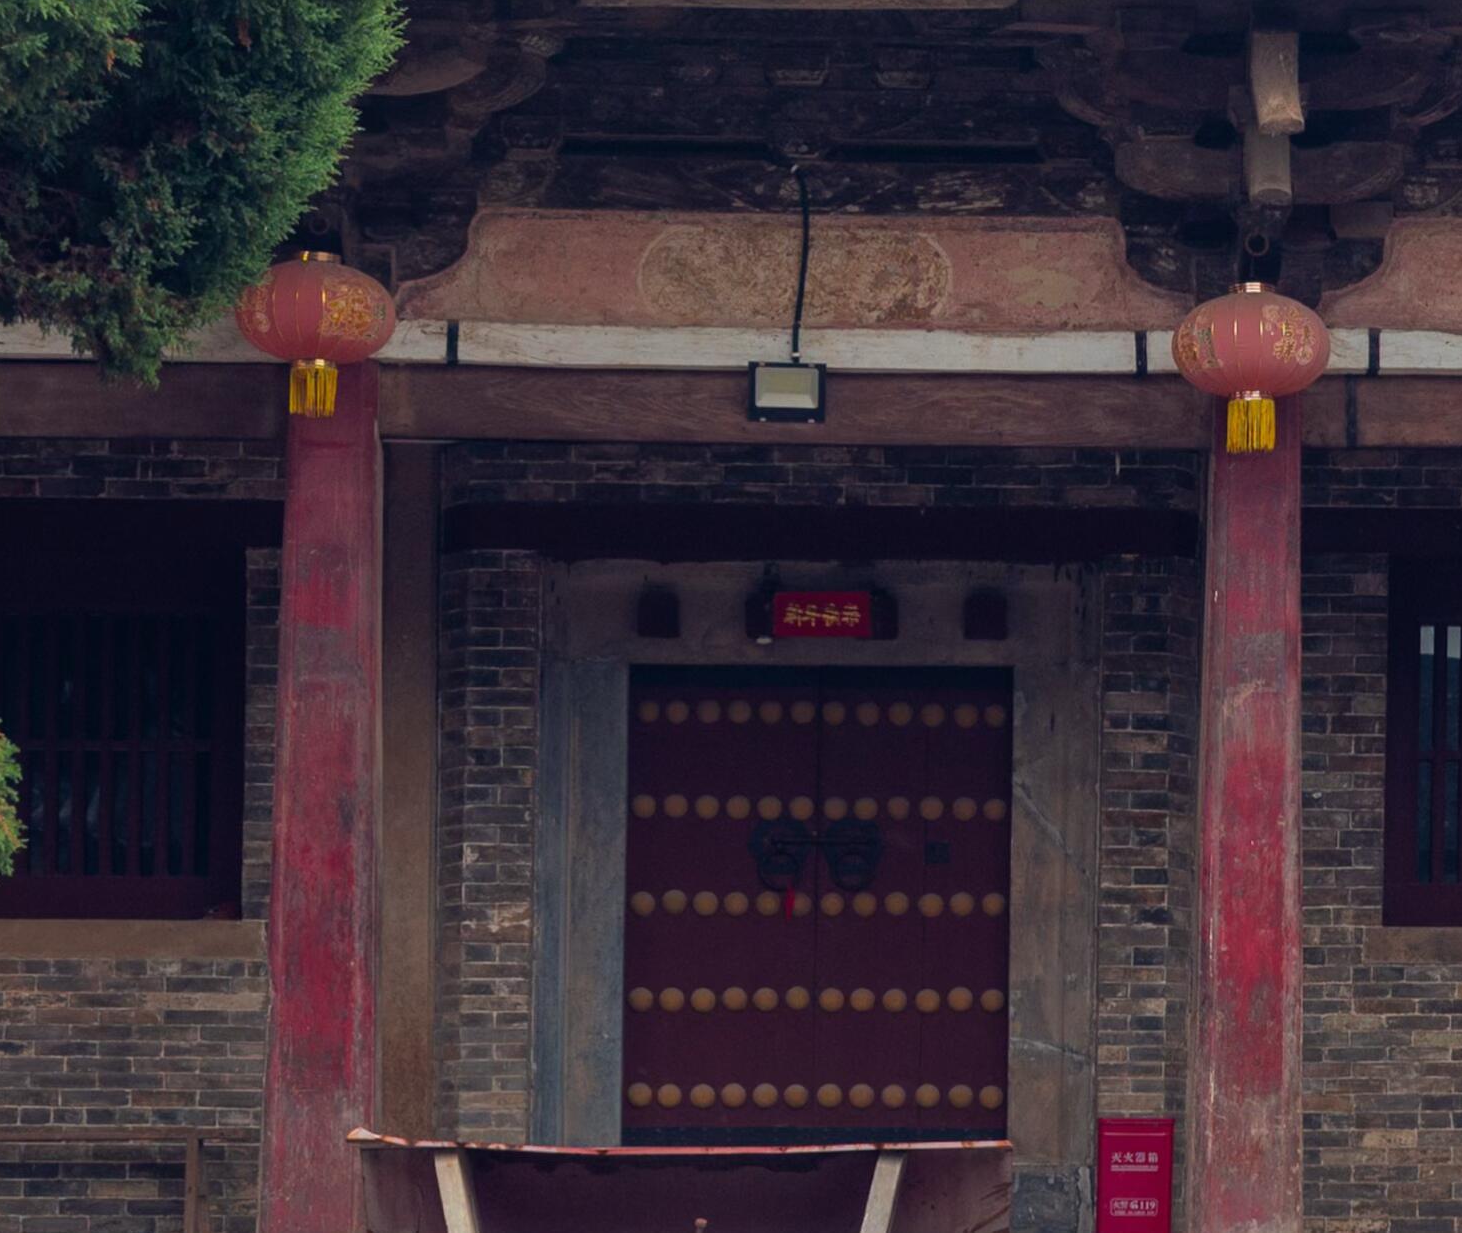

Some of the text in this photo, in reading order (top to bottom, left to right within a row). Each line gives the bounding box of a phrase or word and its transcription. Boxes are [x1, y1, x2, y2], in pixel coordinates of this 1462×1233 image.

[1112, 1152, 1158, 1163] 灭火器箱
[1140, 1200, 1156, 1210] 119
